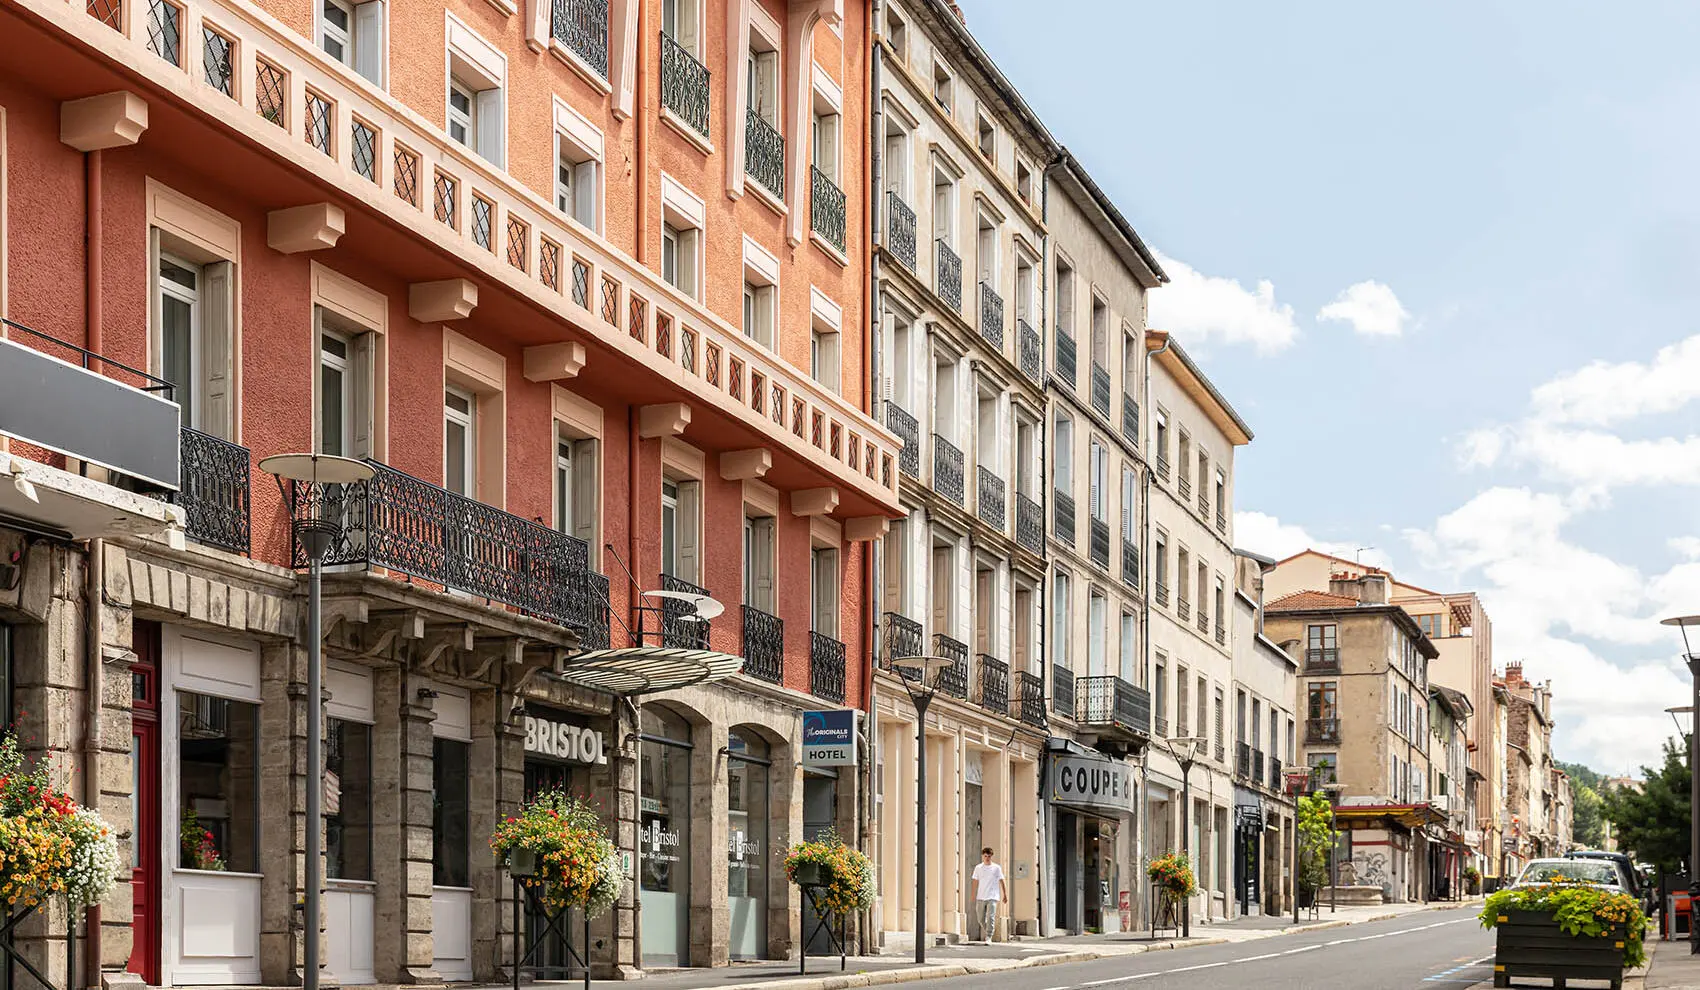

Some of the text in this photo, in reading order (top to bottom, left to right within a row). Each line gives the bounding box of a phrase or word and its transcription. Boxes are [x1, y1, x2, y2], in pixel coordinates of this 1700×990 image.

[524, 716, 607, 765] BRISTOL
[809, 750, 846, 759] HOTEL
[1061, 766, 1118, 797] COUPE
[641, 825, 680, 846] tel Bristol
